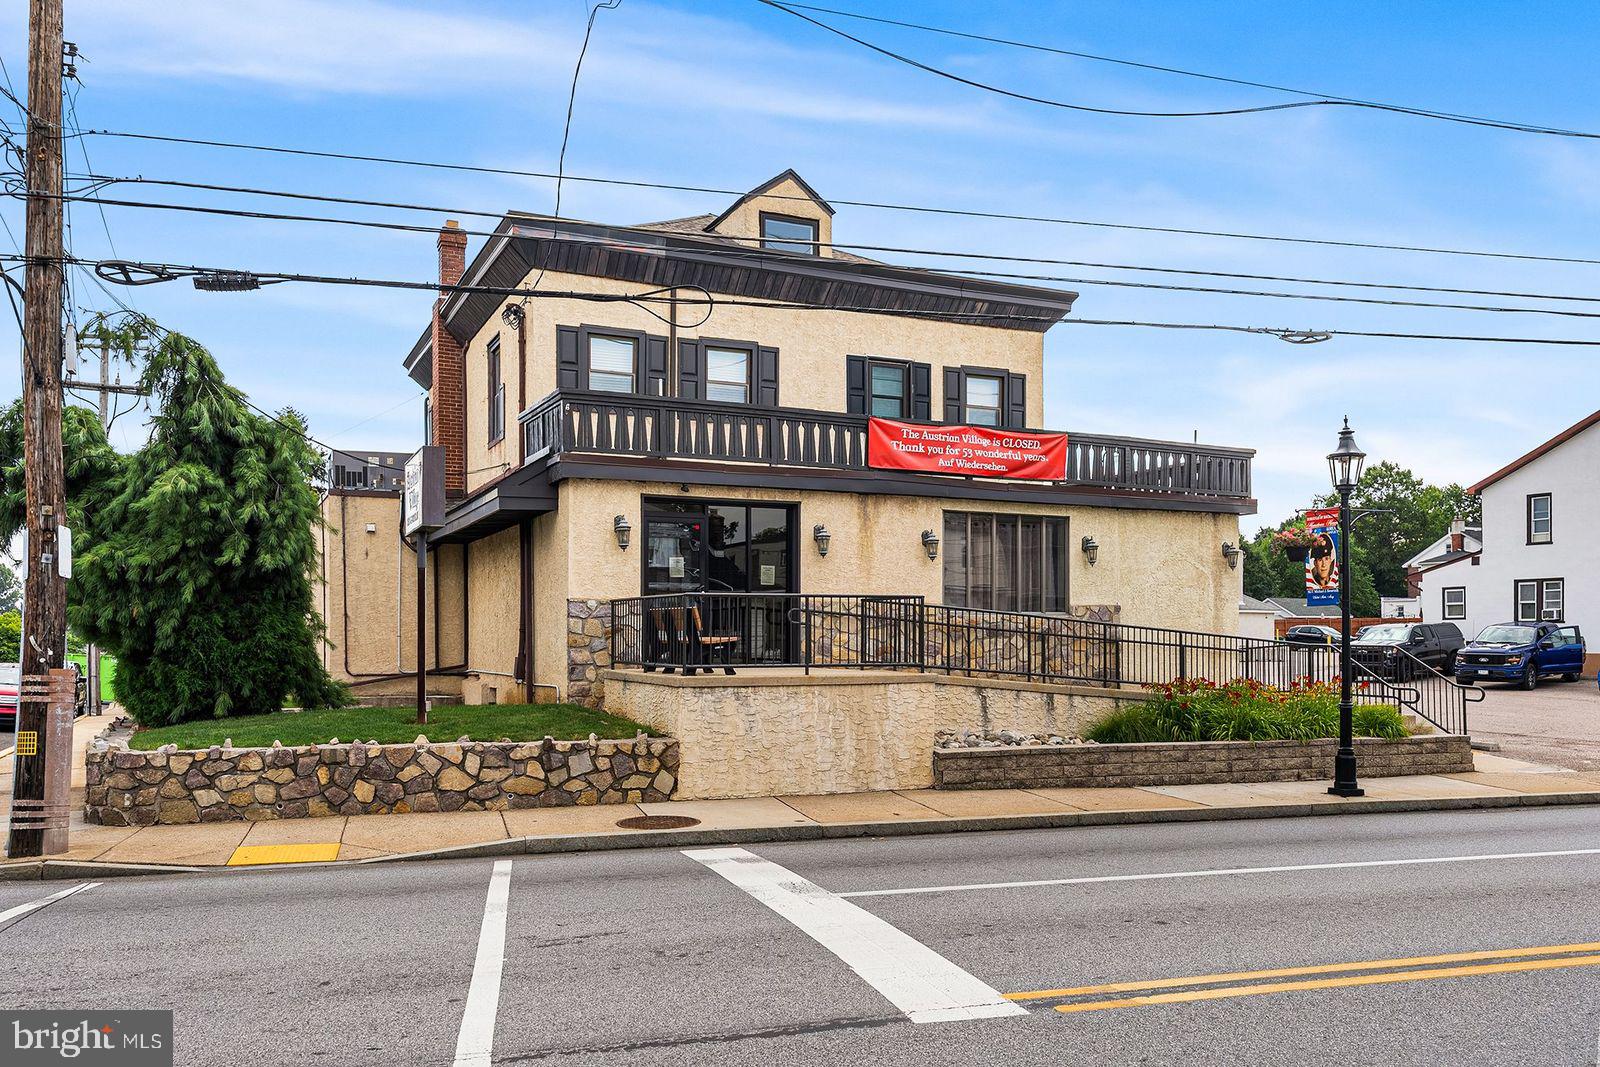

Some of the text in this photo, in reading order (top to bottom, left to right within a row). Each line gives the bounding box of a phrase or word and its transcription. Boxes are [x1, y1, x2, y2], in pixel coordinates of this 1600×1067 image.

[901, 428, 1042, 449] The Austrian Village is CLOSED.
[891, 440, 1049, 462] Thank you for 53 wonderful years.
[938, 458, 1008, 471] Auf Wiedersehen.
